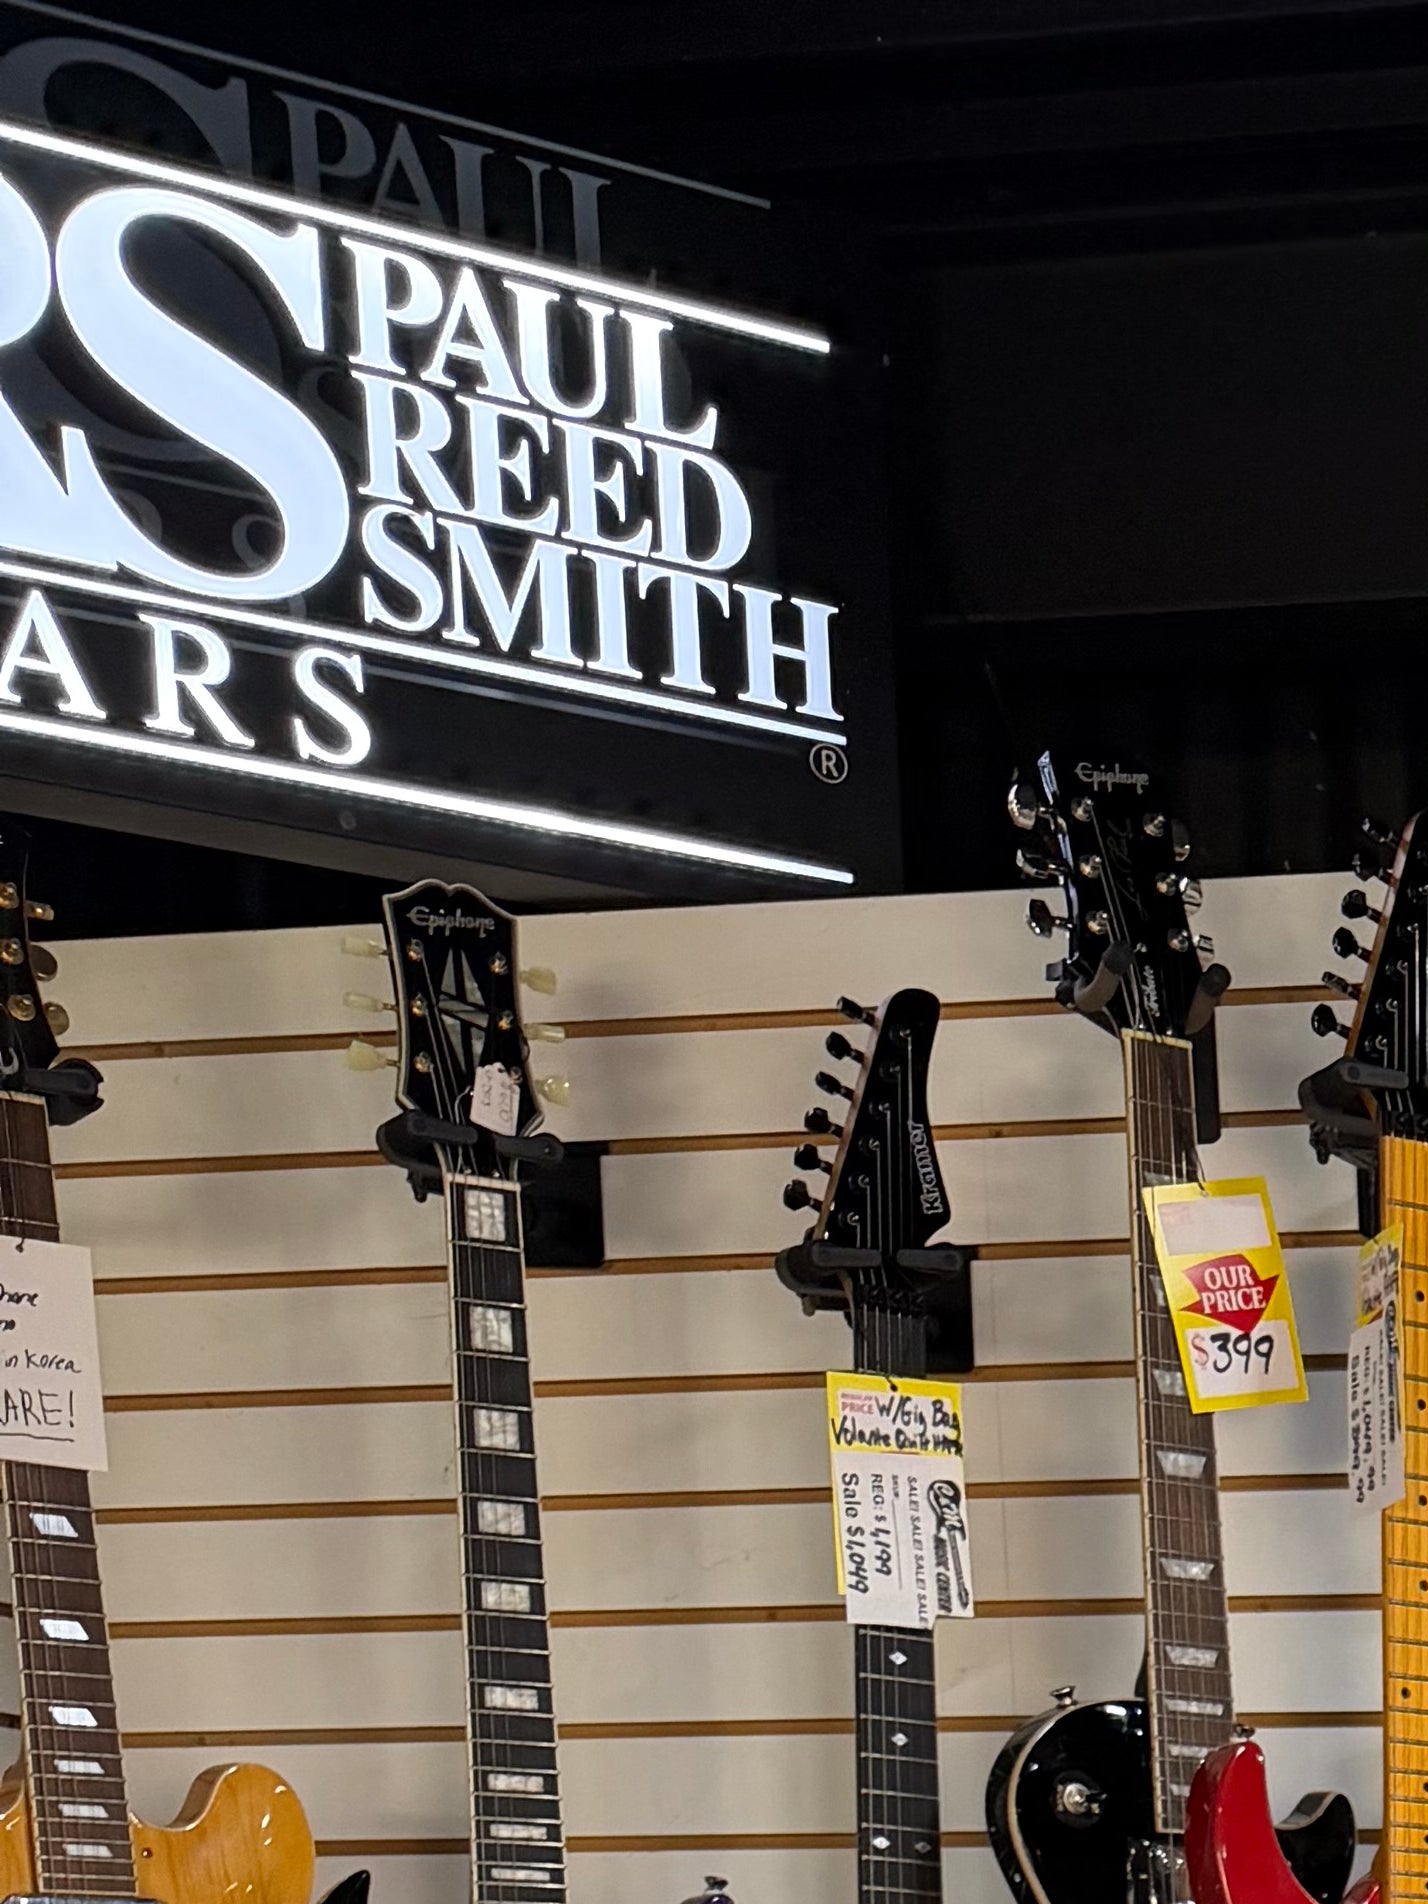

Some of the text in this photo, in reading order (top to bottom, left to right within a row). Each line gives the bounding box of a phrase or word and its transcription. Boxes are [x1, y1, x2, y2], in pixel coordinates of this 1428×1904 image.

[339, 235, 720, 451] PAUL
[352, 369, 753, 572] REED
[360, 502, 845, 723] SMITH
[1074, 761, 1150, 794] Epiphone
[406, 905, 496, 938] Epiphone
[907, 1120, 944, 1215] Kramer
[1203, 1264, 1255, 1291] OUR
[1200, 1287, 1267, 1315] PRICE
[25, 1349, 82, 1374] Korea
[1190, 1331, 1275, 1376] $399
[840, 1400, 875, 1415] PRICE
[841, 1473, 869, 1594] Sale $1,049
